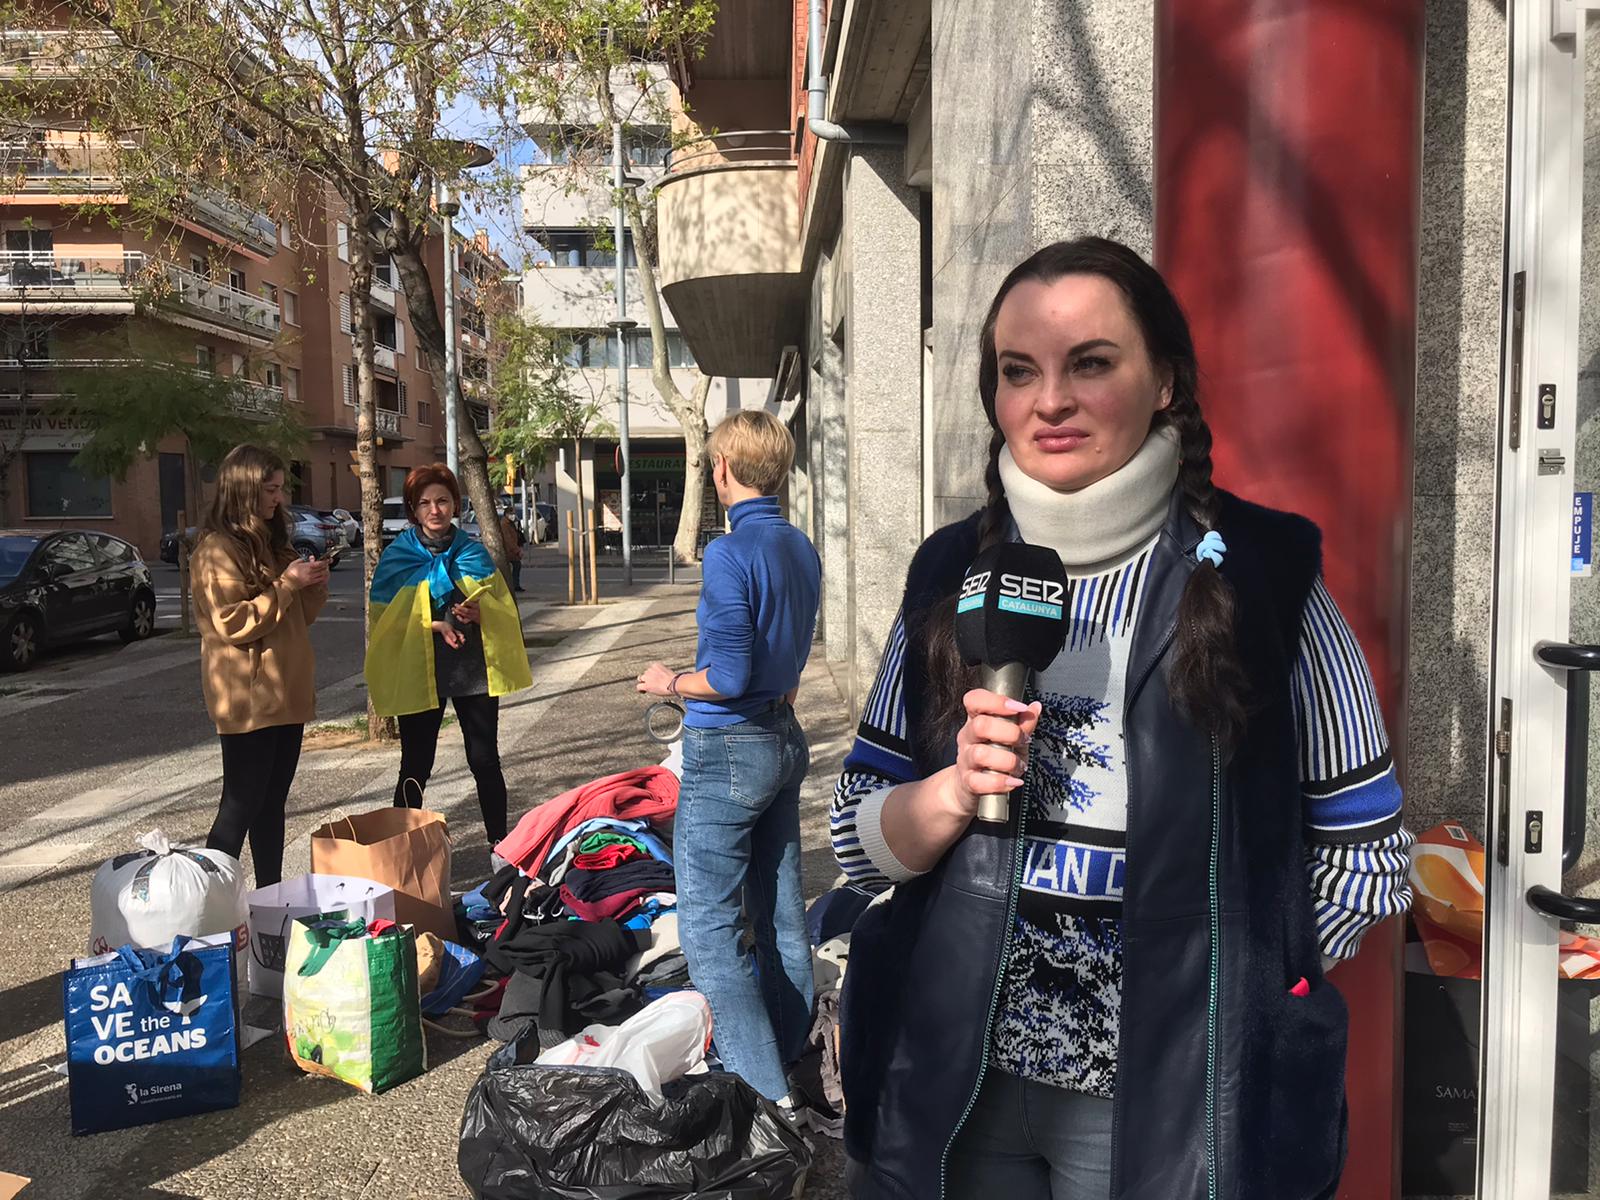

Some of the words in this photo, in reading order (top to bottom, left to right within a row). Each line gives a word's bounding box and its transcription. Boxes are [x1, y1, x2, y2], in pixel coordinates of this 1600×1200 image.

[1573, 497, 1583, 554] EMPUJE
[1001, 599, 1058, 617] CATALUNYA
[90, 982, 133, 1011] SA
[91, 1011, 135, 1040] VE
[140, 1015, 171, 1032] the
[94, 1028, 207, 1065] OCEANS
[140, 1088, 149, 1097] la
[150, 1083, 182, 1095] Sirena
